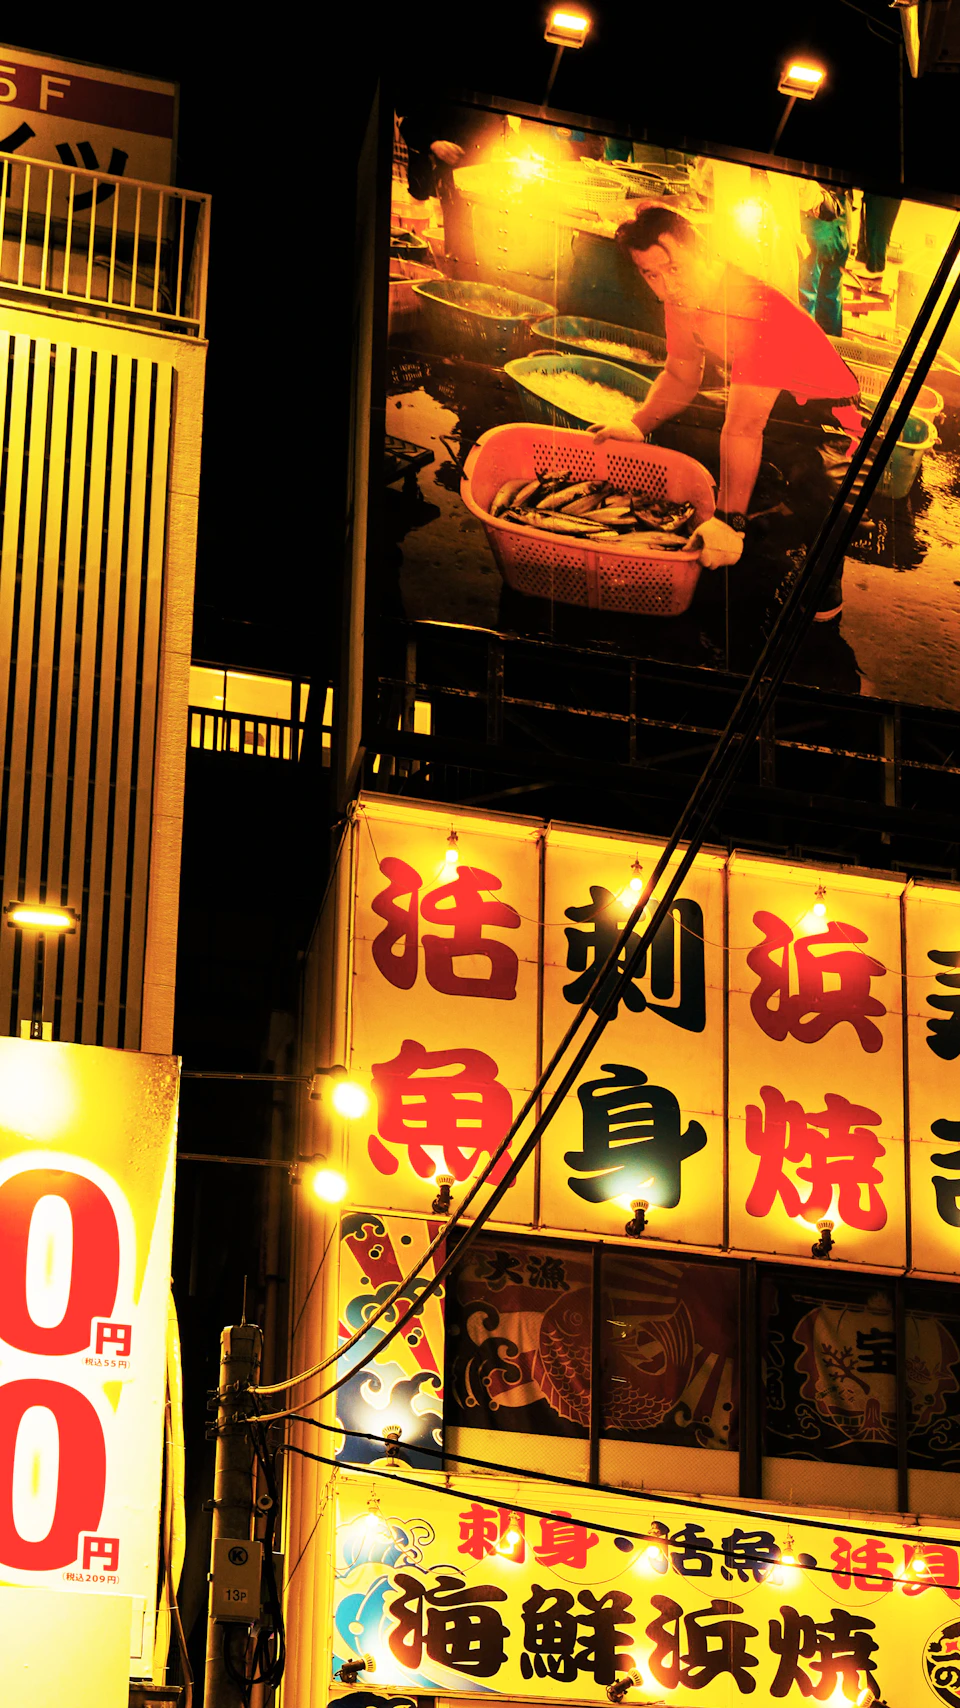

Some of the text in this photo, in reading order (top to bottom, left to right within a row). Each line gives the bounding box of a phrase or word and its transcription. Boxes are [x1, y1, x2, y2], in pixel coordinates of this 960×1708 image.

[0, 64, 71, 112] 5F
[367, 855, 522, 1188] 活魚
[562, 885, 708, 1209] 刺身
[744, 909, 888, 1232] 浜焼
[387, 1572, 881, 1700] 海鮮浜焼
